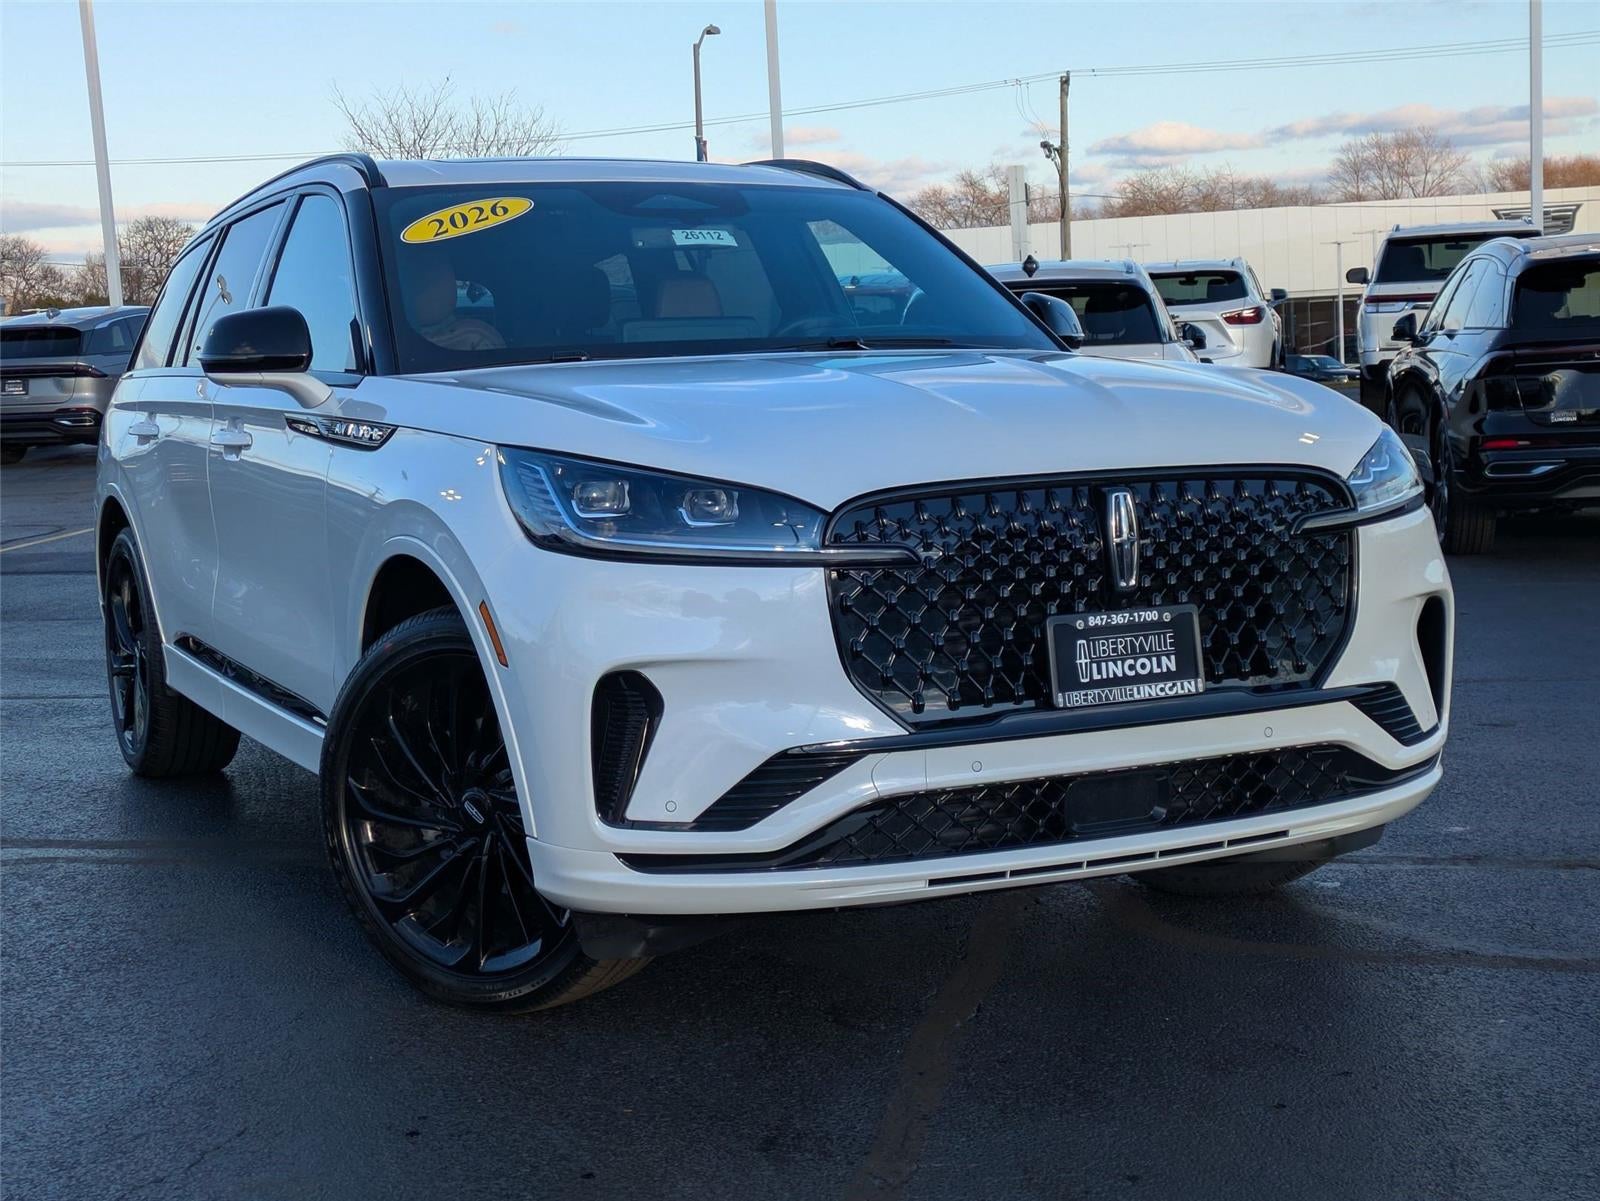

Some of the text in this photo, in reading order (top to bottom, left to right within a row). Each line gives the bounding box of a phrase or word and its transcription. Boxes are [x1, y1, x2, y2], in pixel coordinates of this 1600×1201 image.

[427, 200, 509, 238] 2026
[681, 231, 724, 240] 26112
[1088, 610, 1159, 627] 847-367-1700
[1089, 633, 1175, 659] LIBERTYVILLE
[1091, 655, 1177, 681] LINCOLN
